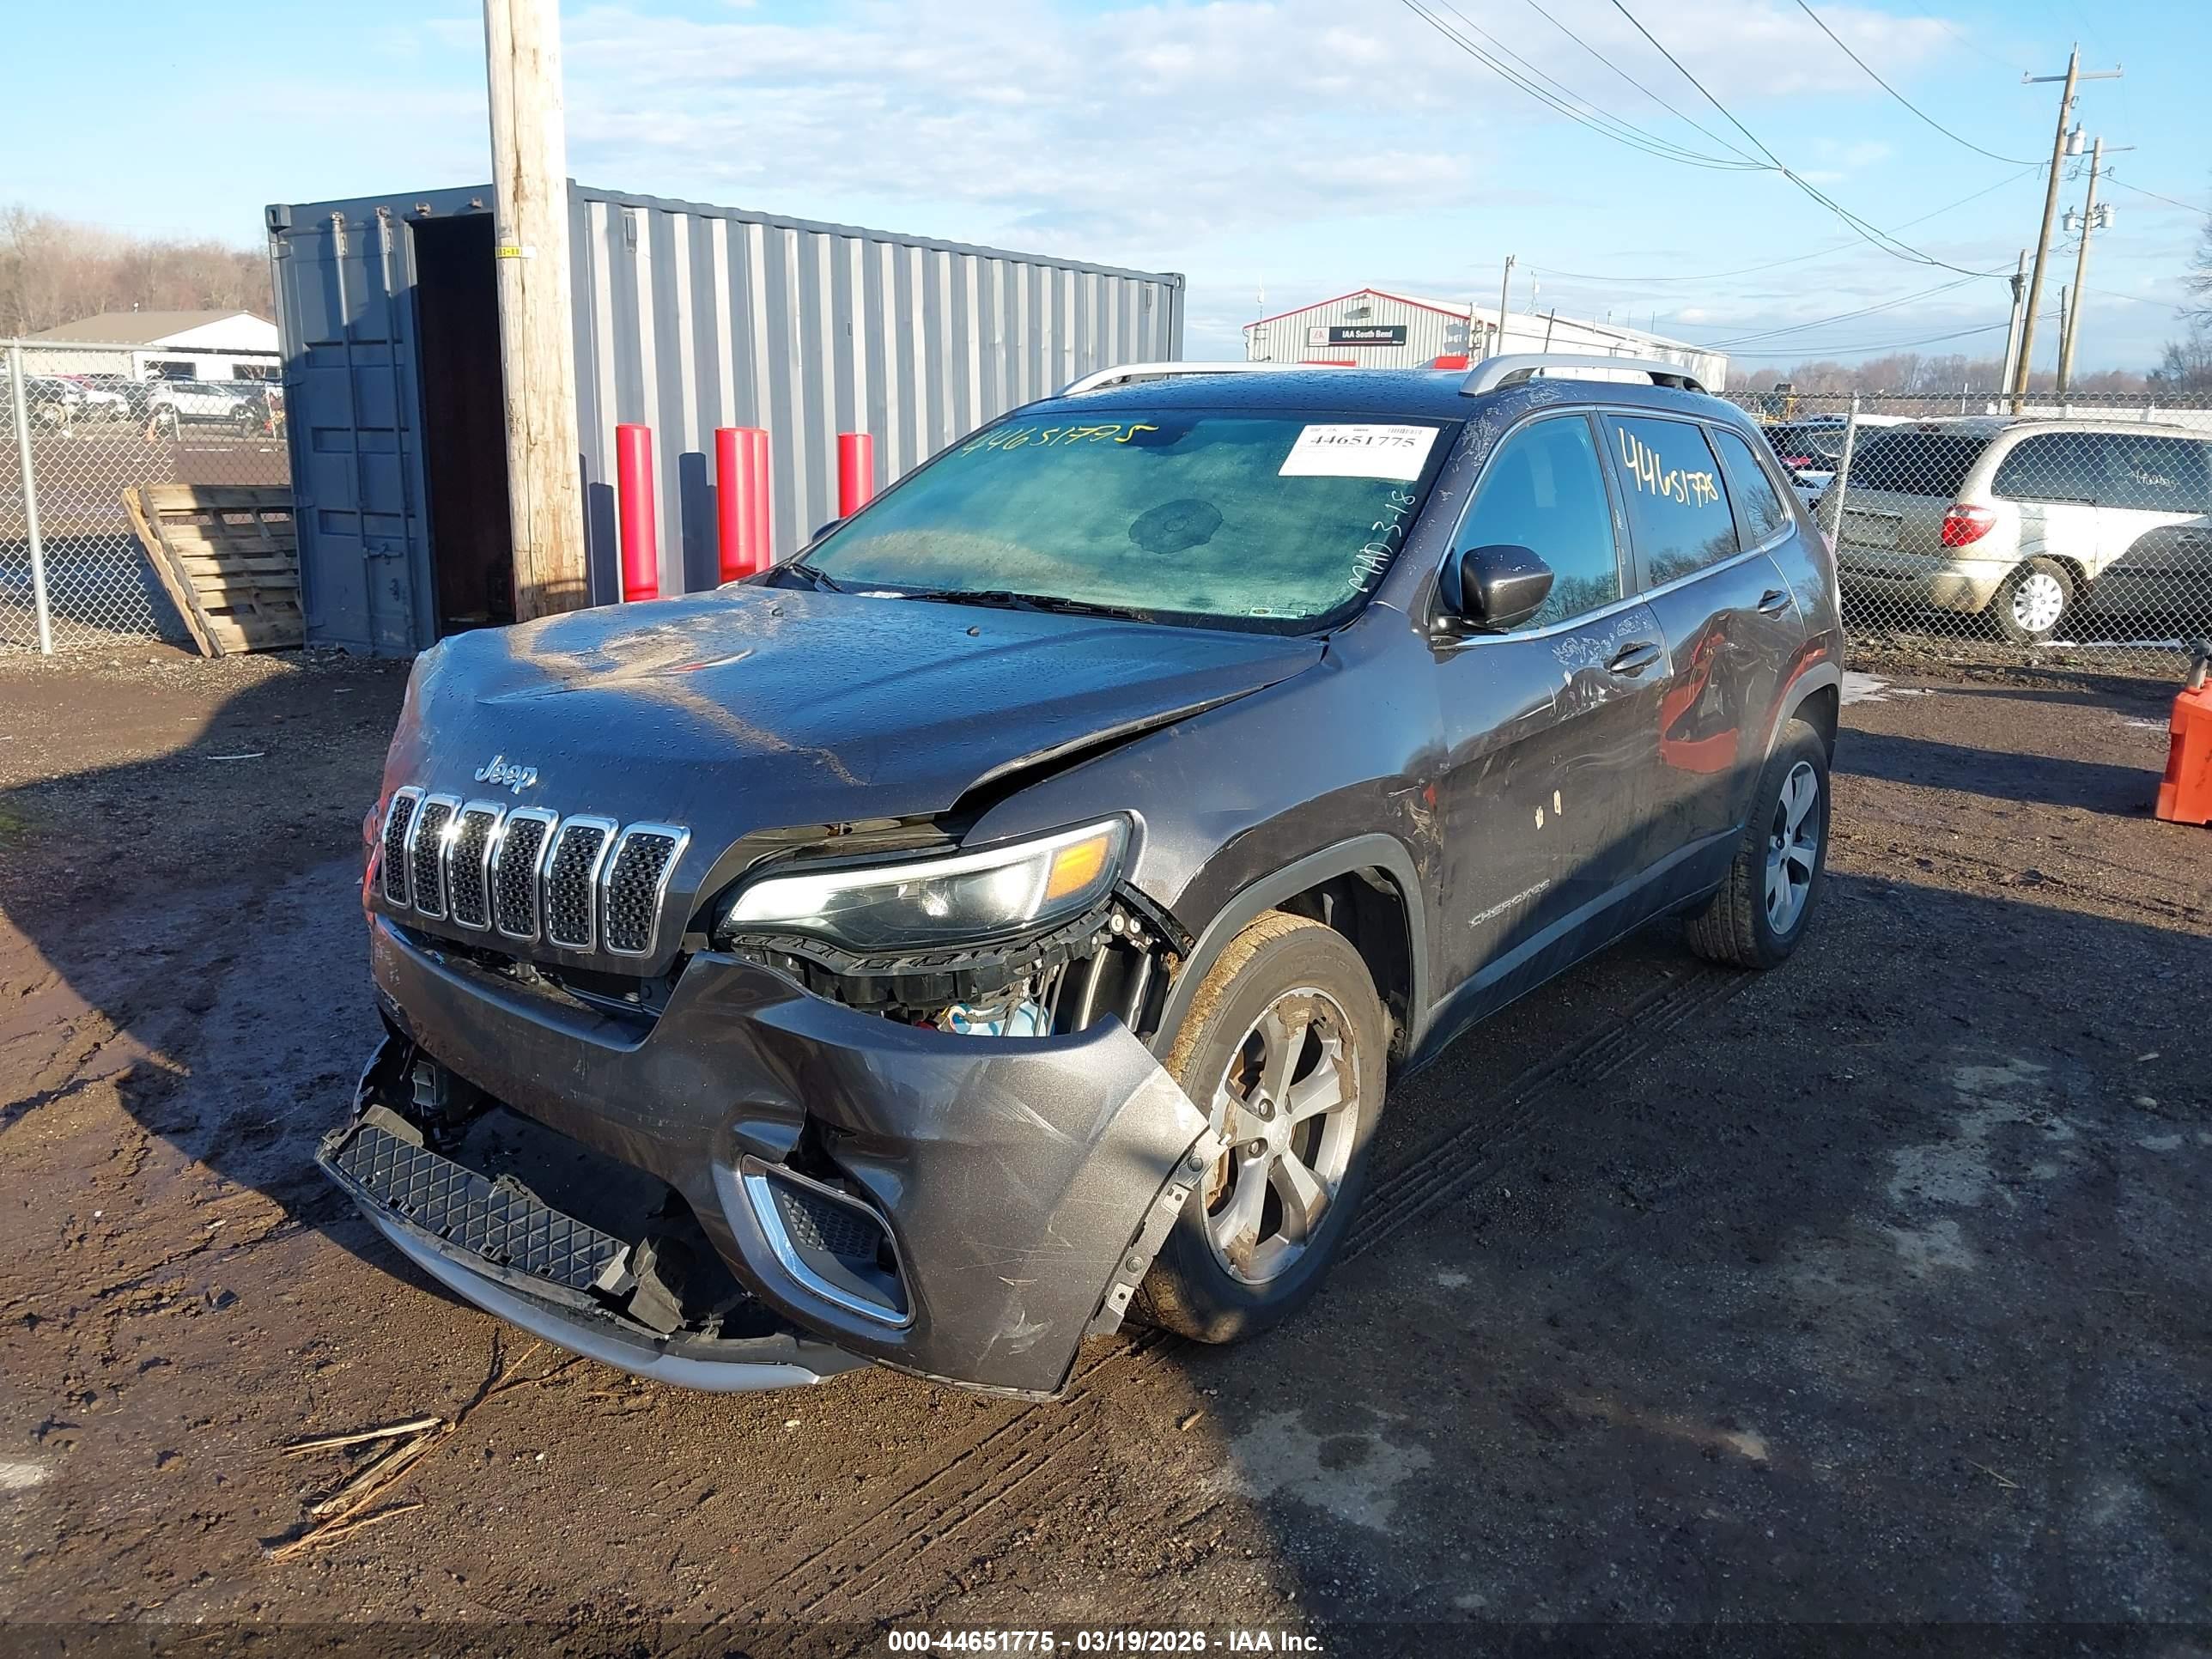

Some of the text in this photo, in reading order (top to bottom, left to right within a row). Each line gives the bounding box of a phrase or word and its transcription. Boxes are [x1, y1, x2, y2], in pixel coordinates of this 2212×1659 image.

[1310, 435, 1416, 447] 44651775
[1347, 489, 1416, 592] MAD 3-18
[474, 755, 538, 795] Jeep
[1468, 878, 1551, 929] CHEROKEE
